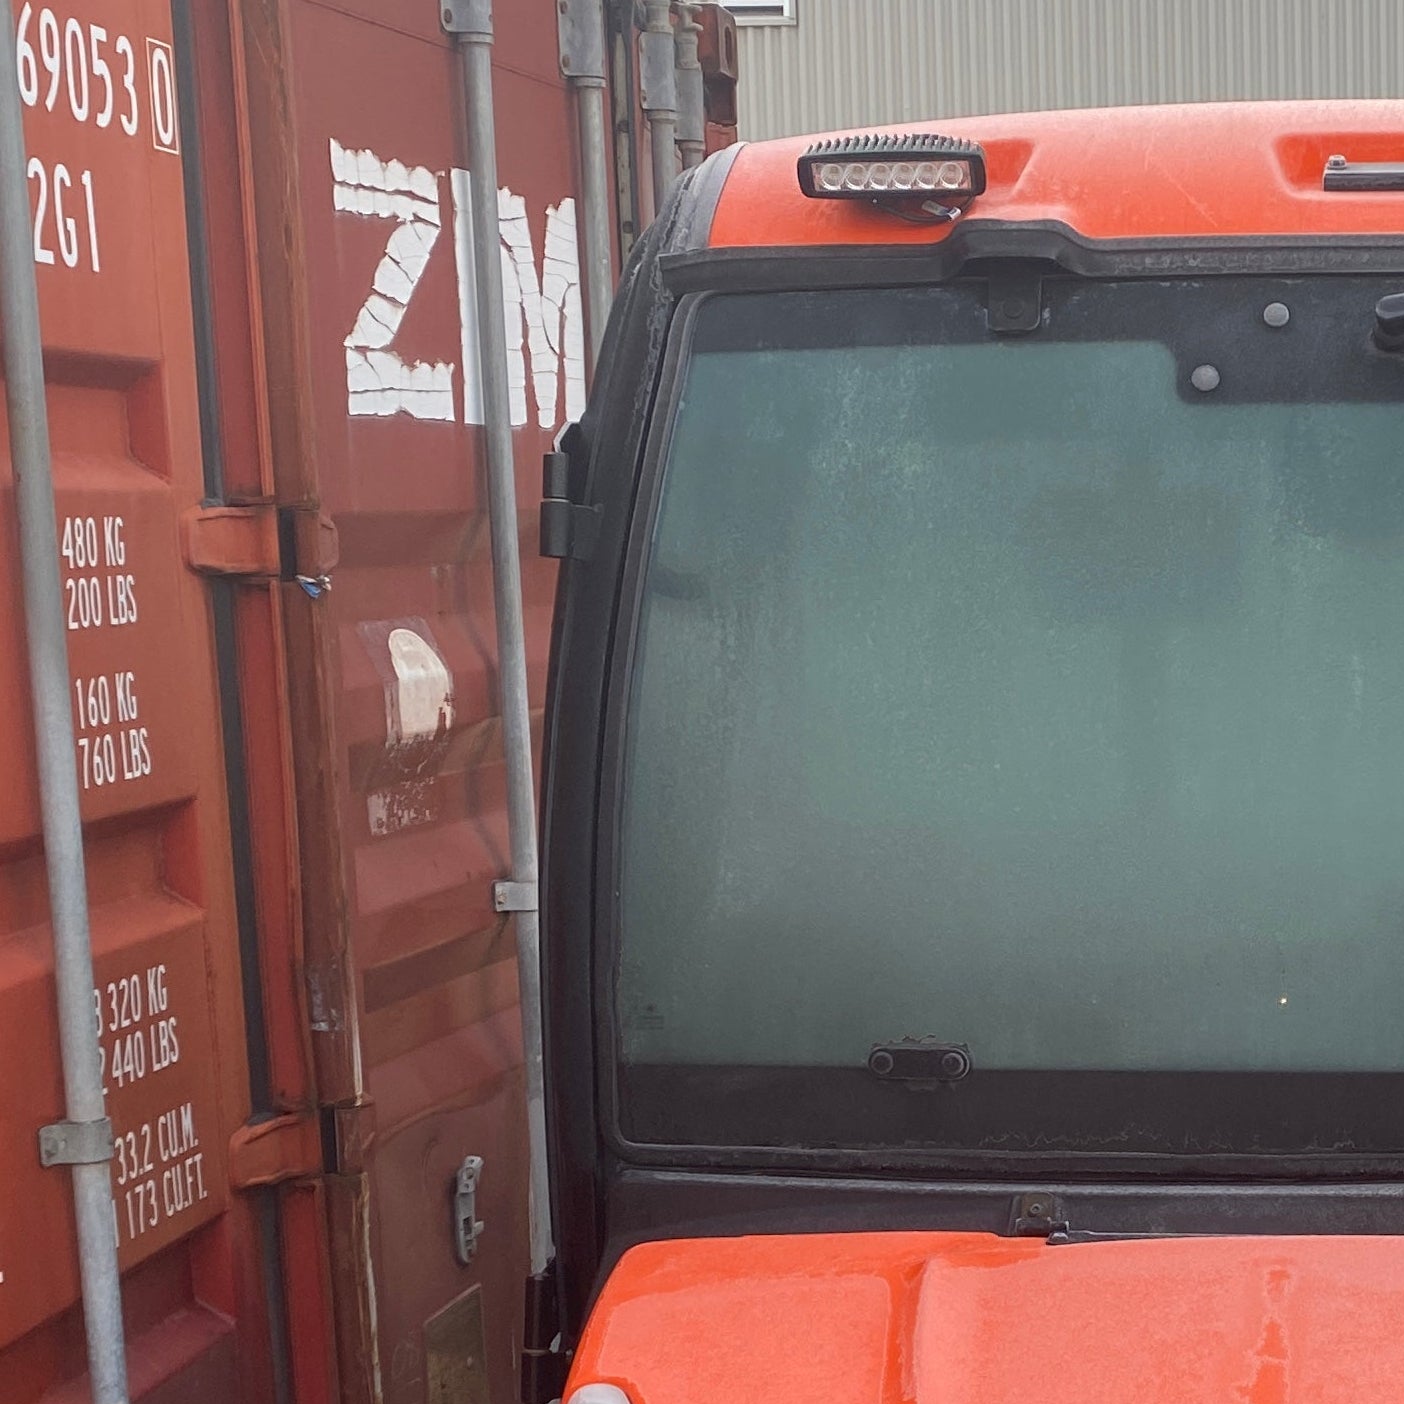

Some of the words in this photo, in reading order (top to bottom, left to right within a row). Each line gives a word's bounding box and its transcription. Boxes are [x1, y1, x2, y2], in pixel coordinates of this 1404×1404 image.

[16, 2, 138, 136] 69053
[27, 157, 100, 272] 2G1
[62, 516, 98, 569] 480
[103, 516, 125, 567] KG
[65, 576, 102, 630] 200
[106, 574, 137, 625] LBS
[75, 675, 110, 729] 160
[114, 671, 137, 722] KG
[78, 733, 115, 789] 760
[120, 727, 151, 780] LBS
[107, 974, 142, 1031] 320
[147, 964, 167, 1016] KG
[112, 1030, 145, 1088] 440
[150, 1016, 179, 1072] LBS
[115, 1123, 154, 1185] 33.2
[126, 1180, 158, 1239] 173
